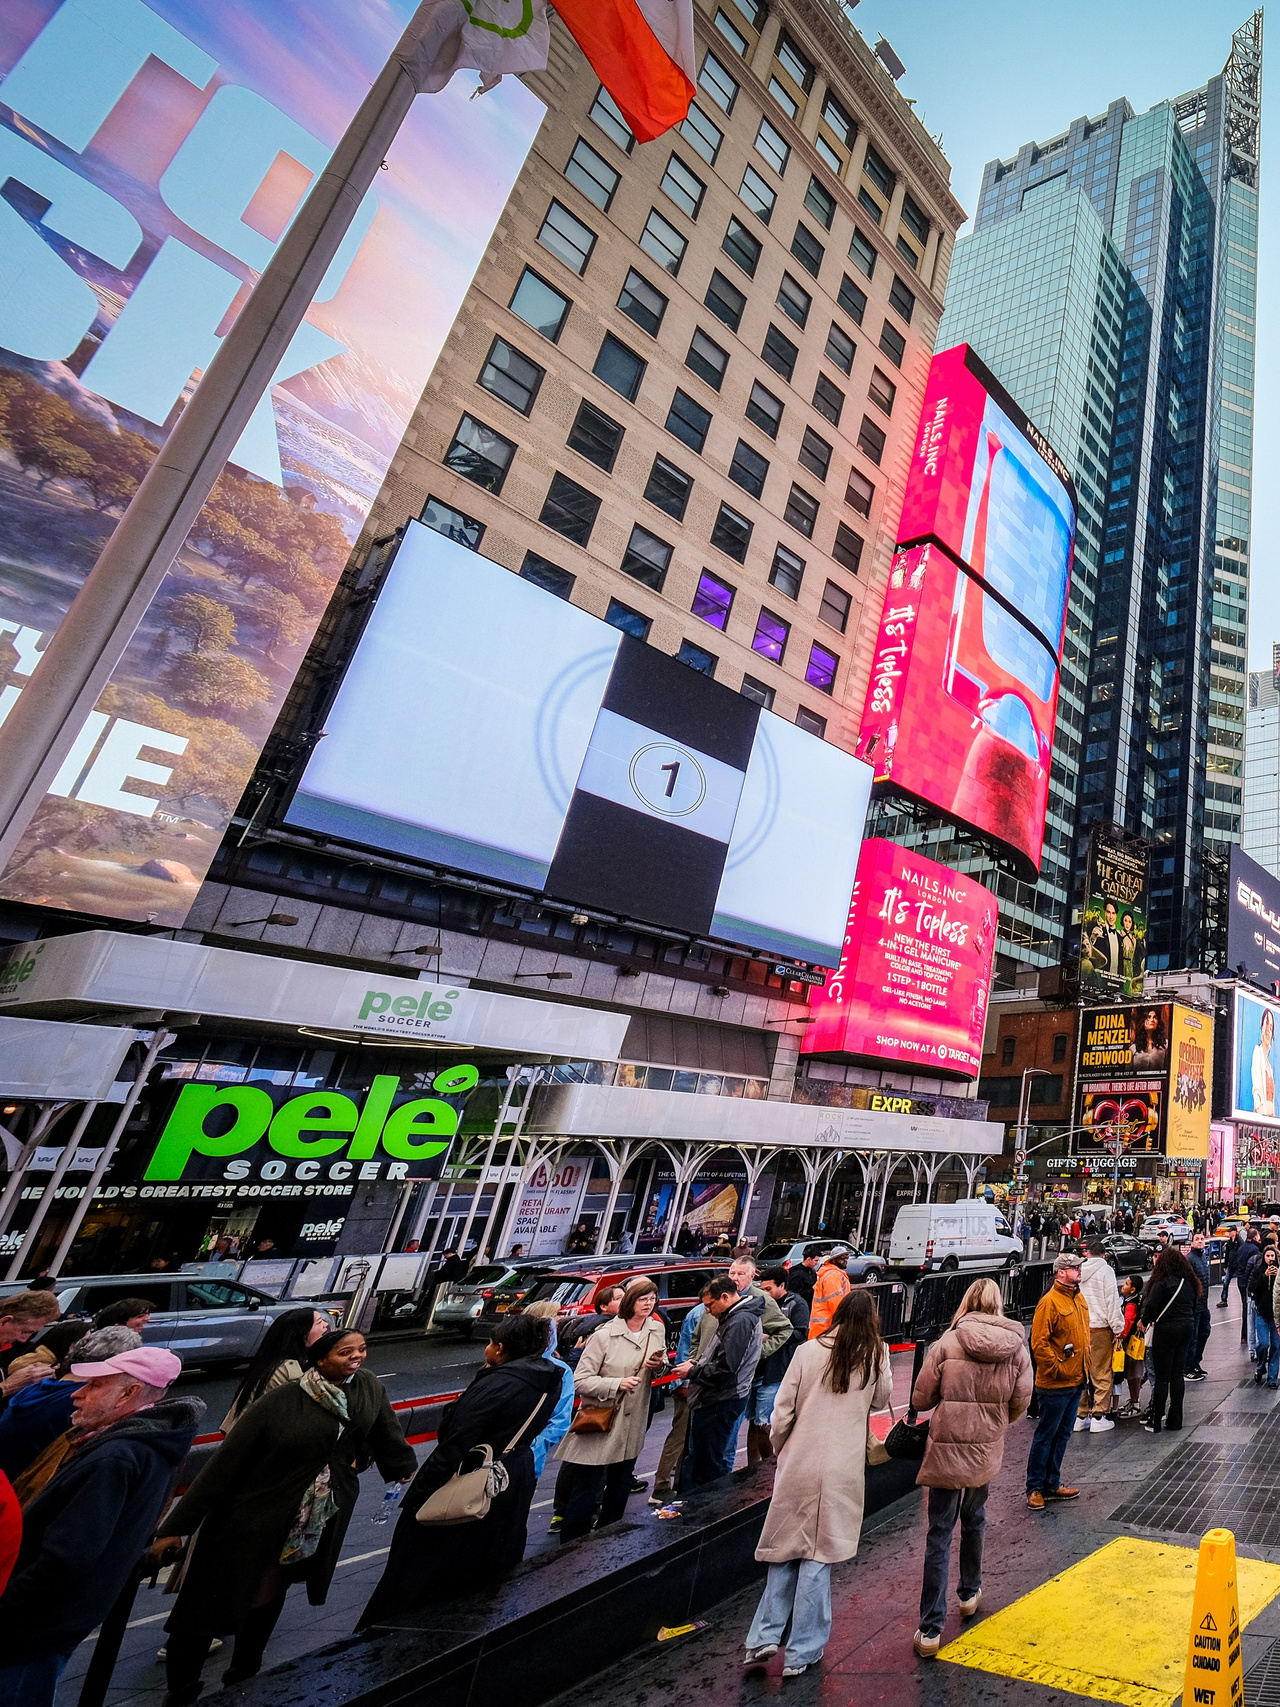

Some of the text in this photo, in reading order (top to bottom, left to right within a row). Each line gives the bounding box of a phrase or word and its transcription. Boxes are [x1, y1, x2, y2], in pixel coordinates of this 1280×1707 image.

[919, 421, 932, 458] LONDON
[660, 760, 681, 798] 1
[1096, 860, 1114, 880] THE
[1114, 869, 1144, 892] GREAT
[917, 889, 947, 906] LONDON
[1101, 878, 1139, 902] GATSBY
[878, 886, 969, 946] It's Topless
[878, 938, 920, 959] 4-IN-1 GEL
[894, 932, 951, 959] NEW THE FIRST
[884, 952, 900, 964] BUILT
[900, 957, 907, 965] IN
[890, 961, 949, 984] COLOR AND TOP COAT
[881, 985, 905, 999] GEL-LIKE
[892, 974, 911, 986] STEP
[921, 981, 948, 997] BOTTLE
[357, 989, 460, 1021] pelé
[898, 996, 932, 1011] NO ACETONE
[378, 1014, 431, 1029] SOCCER
[1095, 1013, 1126, 1030] IDINA
[1086, 1028, 1131, 1046] MENZEL
[876, 1035, 899, 1047] SHOP
[899, 1039, 920, 1052] NOW
[920, 1043, 931, 1054] AT
[947, 1047, 970, 1064] TARGET
[1082, 1049, 1133, 1066] REDWOOD
[819, 1111, 843, 1120] ROCK
[871, 1095, 936, 1116] EXPRESS
[143, 1064, 480, 1181] pelé
[223, 1159, 409, 1181] SOCCER
[1046, 1158, 1078, 1168] GIFTS
[1085, 1158, 1137, 1168] LUGGAGE
[139, 1184, 354, 1199] GREATEST SOCCER STORE
[300, 1217, 346, 1237] pelé
[1194, 1634, 1221, 1652] CAUTION
[1192, 1654, 1221, 1672] CUIDADO
[1193, 1686, 1216, 1706] WET
